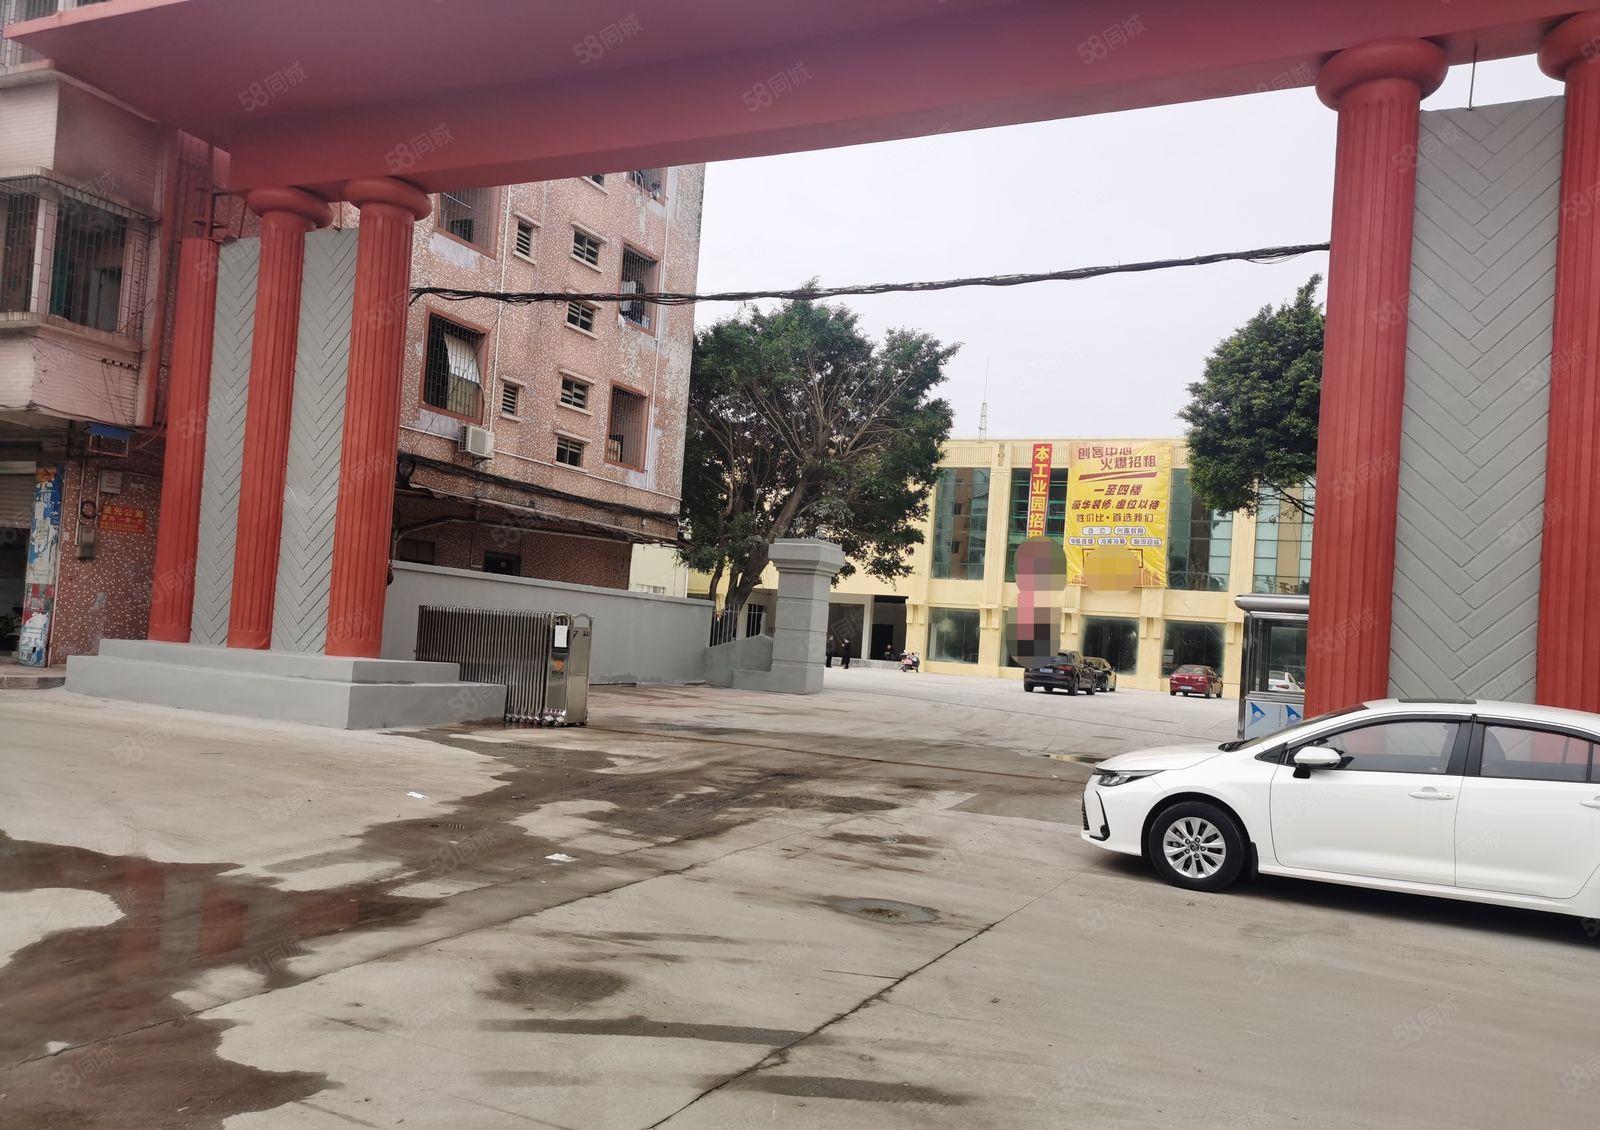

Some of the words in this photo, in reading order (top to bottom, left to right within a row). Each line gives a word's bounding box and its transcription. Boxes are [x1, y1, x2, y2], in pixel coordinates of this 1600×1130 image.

[1077, 446, 1132, 459] 创客中心
[1100, 455, 1156, 470] 火爆招租
[1093, 484, 1143, 495] 一至四楼
